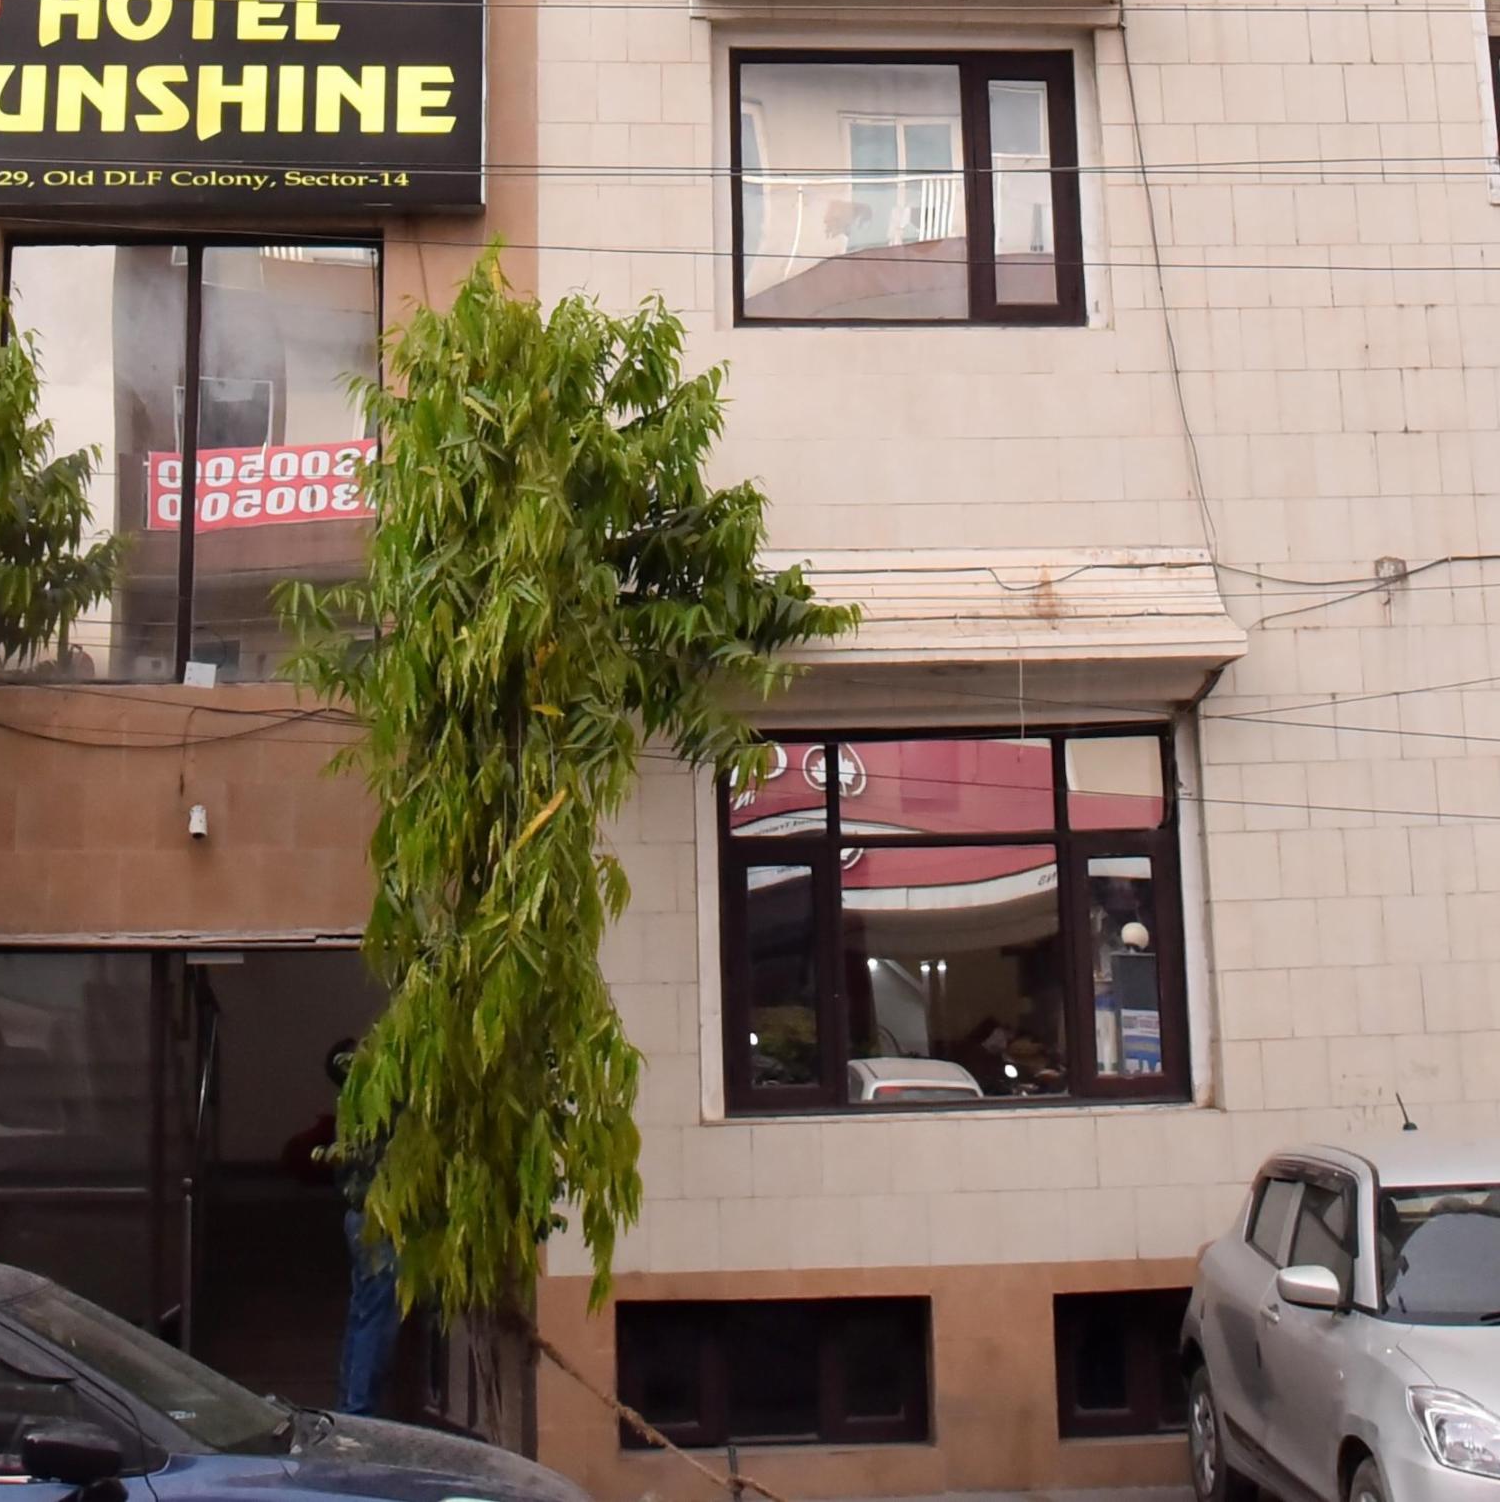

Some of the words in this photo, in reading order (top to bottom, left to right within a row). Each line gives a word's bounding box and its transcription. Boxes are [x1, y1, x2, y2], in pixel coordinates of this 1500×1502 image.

[43, 170, 95, 187] Old
[103, 170, 164, 187] DLF
[172, 170, 277, 193] Colony,
[284, 170, 410, 187] Sector-14
